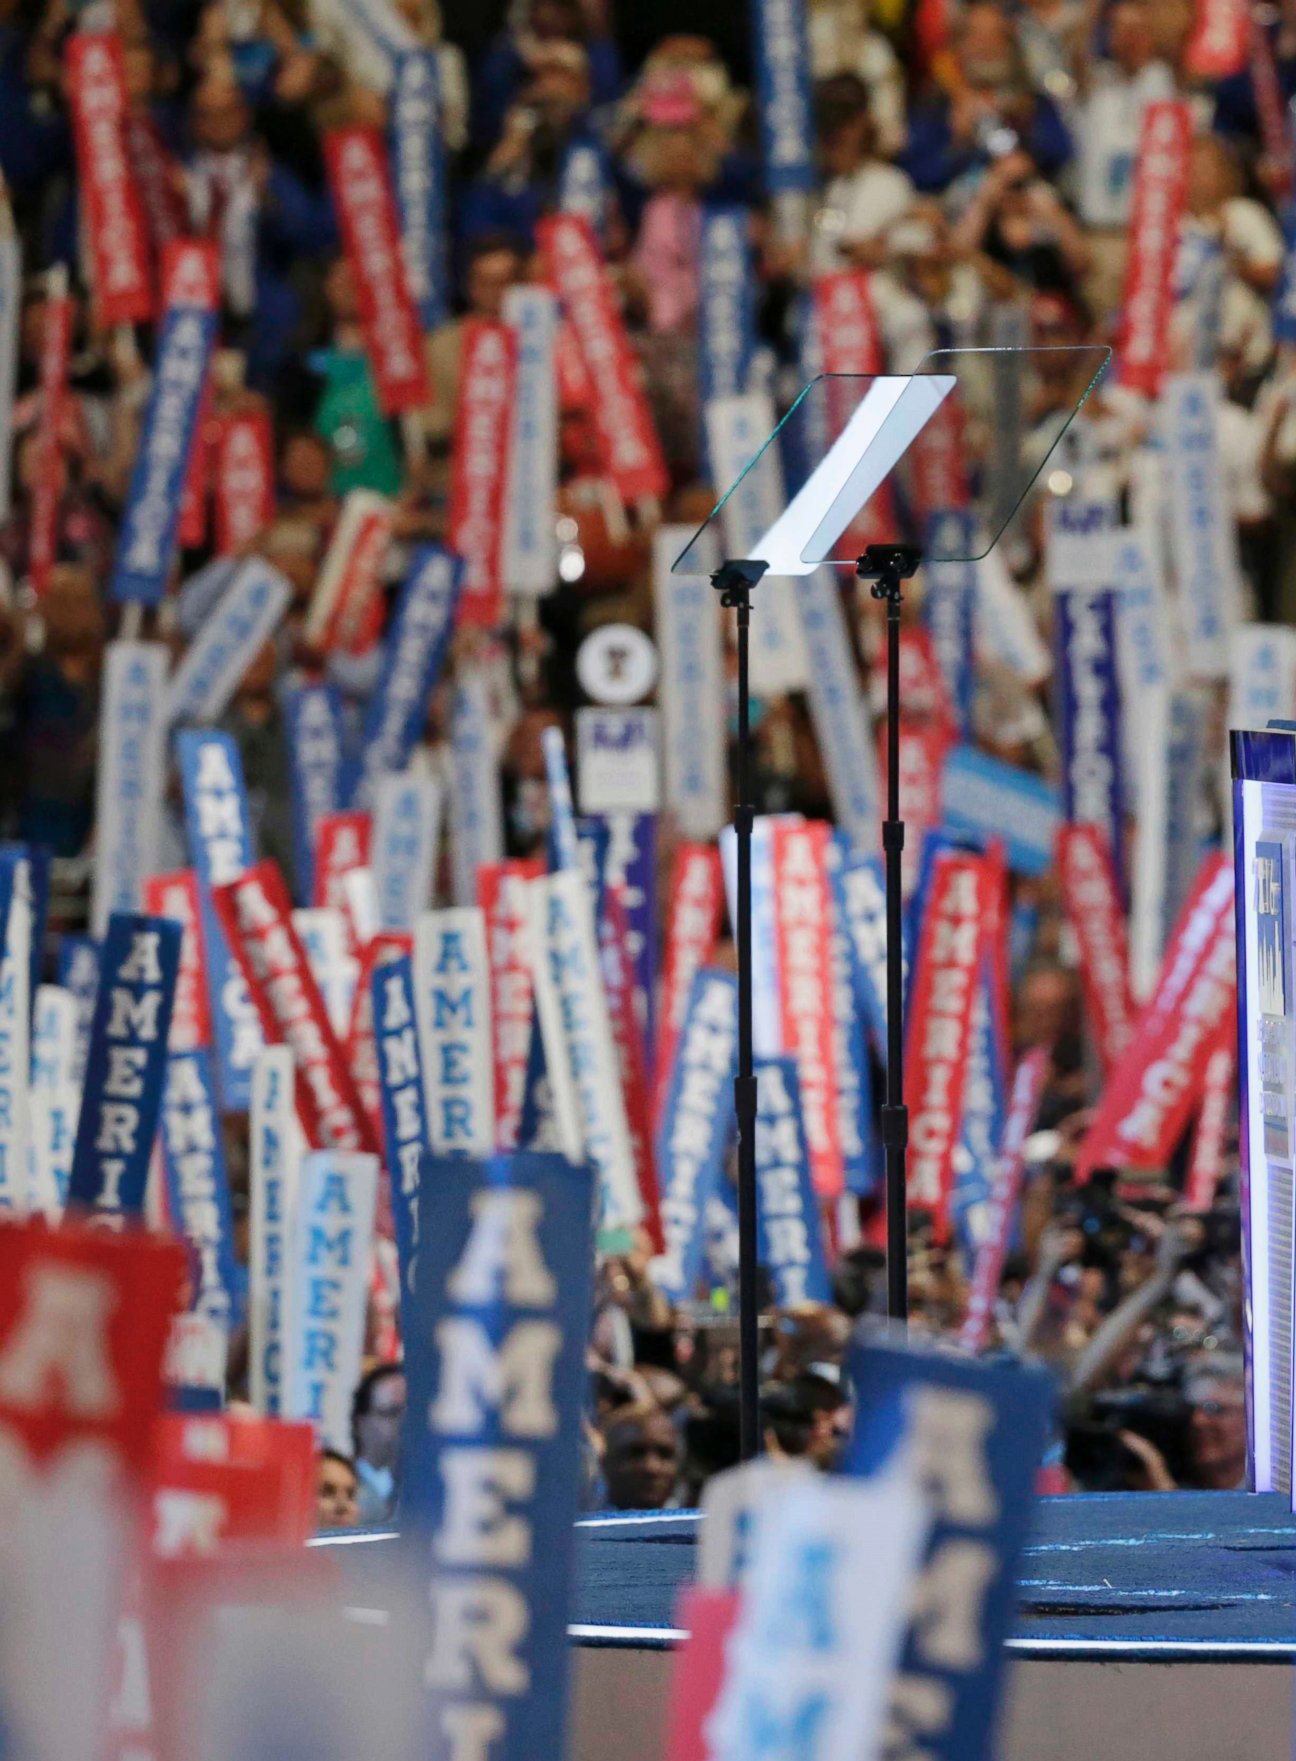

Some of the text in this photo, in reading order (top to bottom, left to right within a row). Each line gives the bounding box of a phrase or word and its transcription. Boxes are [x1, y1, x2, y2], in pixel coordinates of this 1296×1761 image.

[384, 974, 424, 1294] AMERI
[432, 930, 475, 1158] AMER
[906, 870, 980, 1199] AMERICA
[304, 1172, 354, 1418] AMERI
